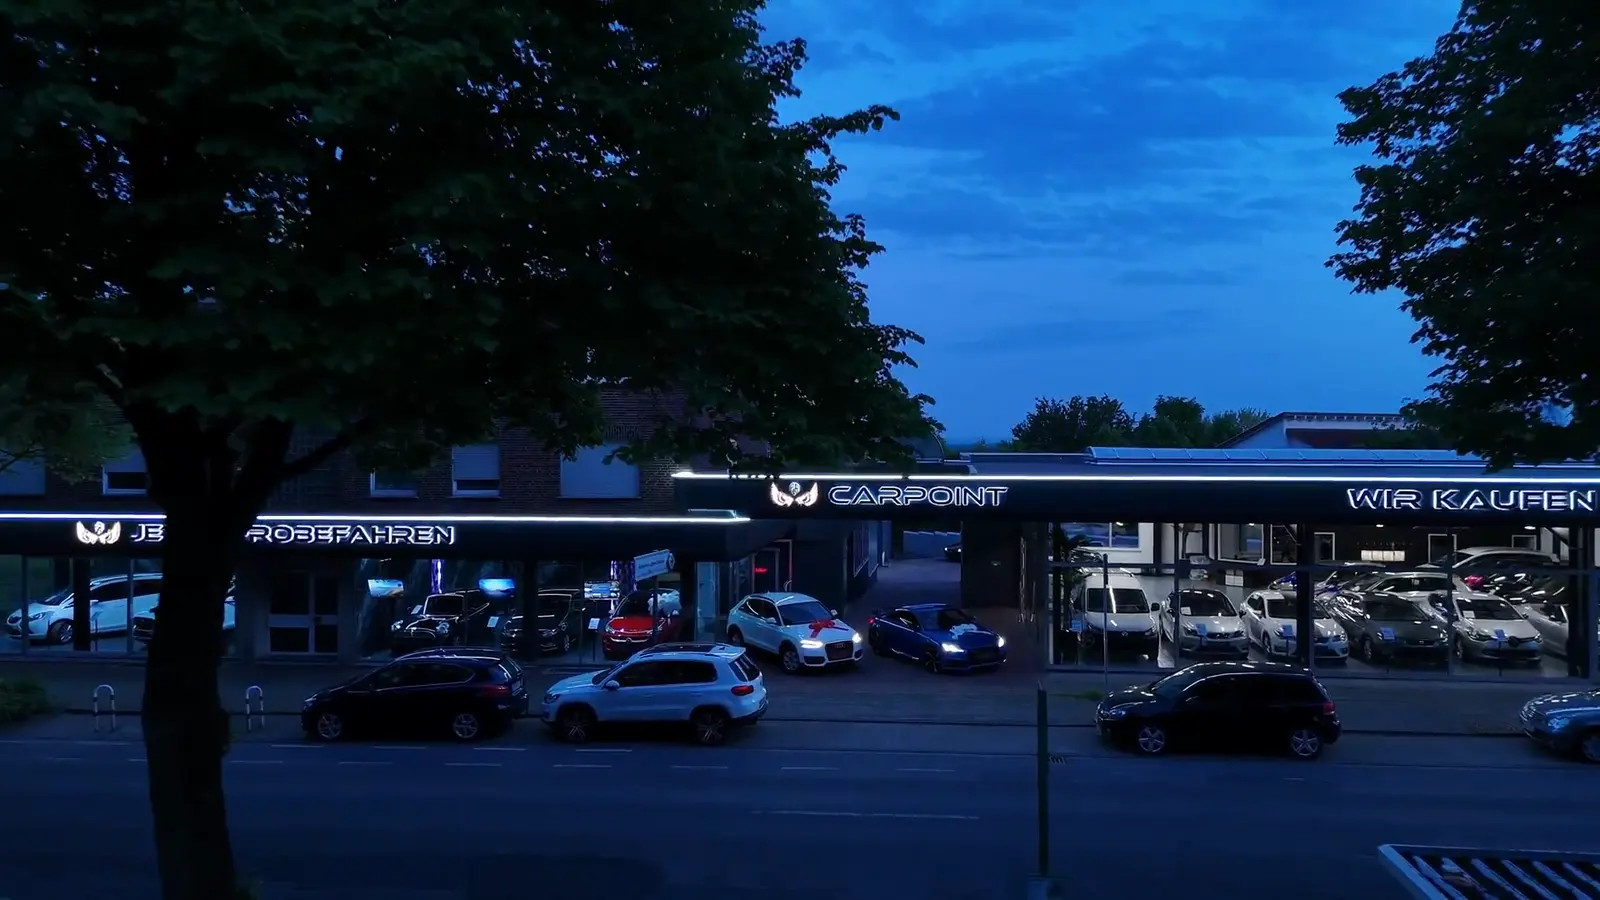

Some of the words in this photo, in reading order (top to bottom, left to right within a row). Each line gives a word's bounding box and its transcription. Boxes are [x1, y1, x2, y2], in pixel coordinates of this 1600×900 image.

[827, 484, 1009, 507] CARPOINT
[1346, 487, 1424, 511] WIR
[1432, 488, 1596, 512] KAUFEN
[130, 523, 168, 543] JE
[244, 524, 455, 546] ROBEFAHREN
